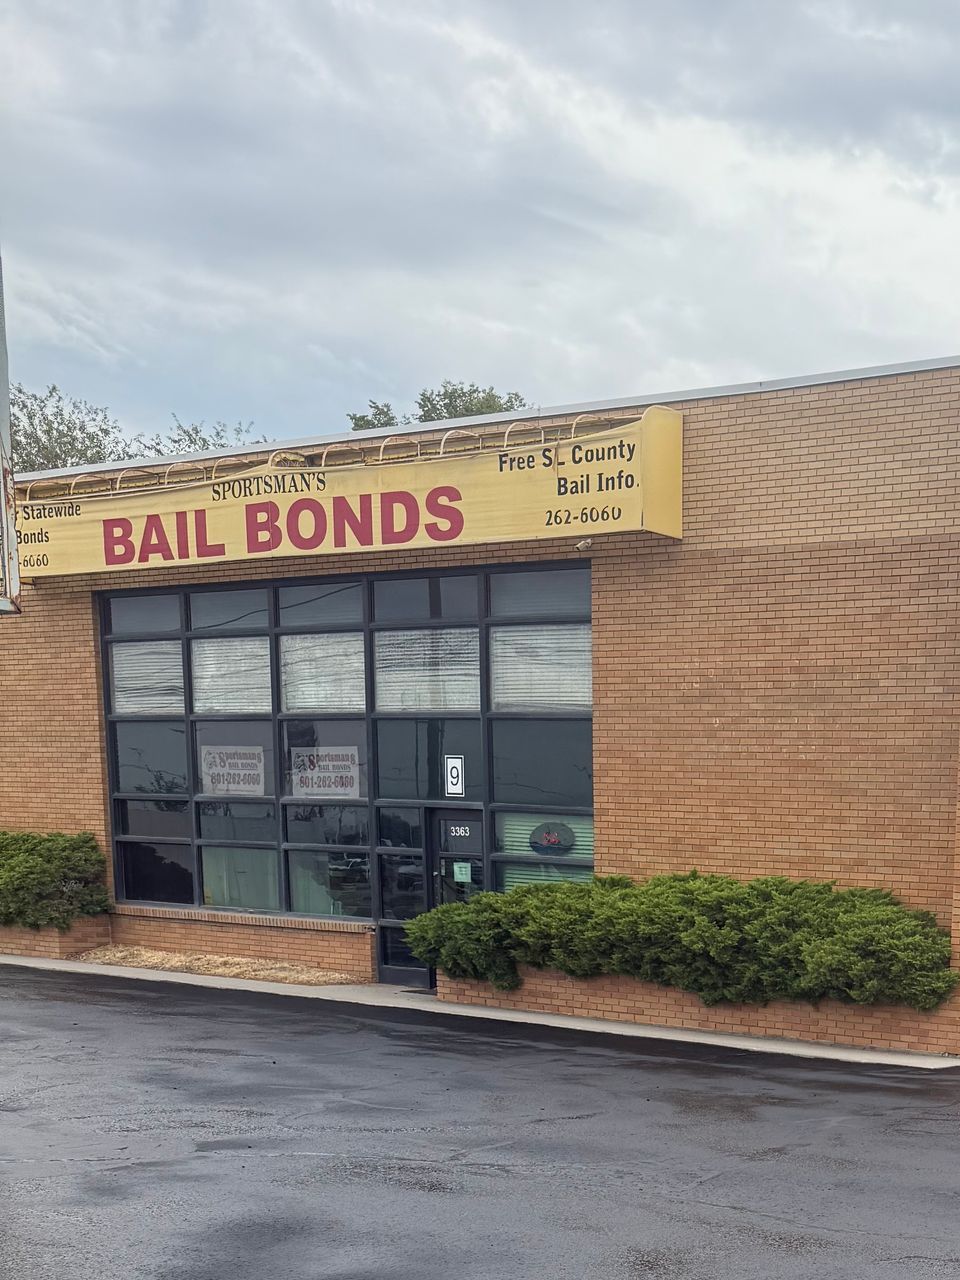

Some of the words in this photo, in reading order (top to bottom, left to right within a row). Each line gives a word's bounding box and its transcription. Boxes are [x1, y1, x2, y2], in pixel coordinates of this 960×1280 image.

[498, 453, 535, 472] Free
[571, 439, 636, 464] County
[211, 472, 327, 502] SPORTSMAN'S
[557, 473, 590, 496] Bail
[596, 469, 640, 492] Info.
[23, 502, 81, 521] Statewide
[545, 505, 622, 526] 262-6060
[102, 508, 226, 566] BAIL
[244, 485, 465, 554] BONDS
[16, 528, 50, 545] Bonds
[18, 553, 49, 568] -6060
[450, 766, 460, 786] 9
[450, 826, 470, 837] 3363
